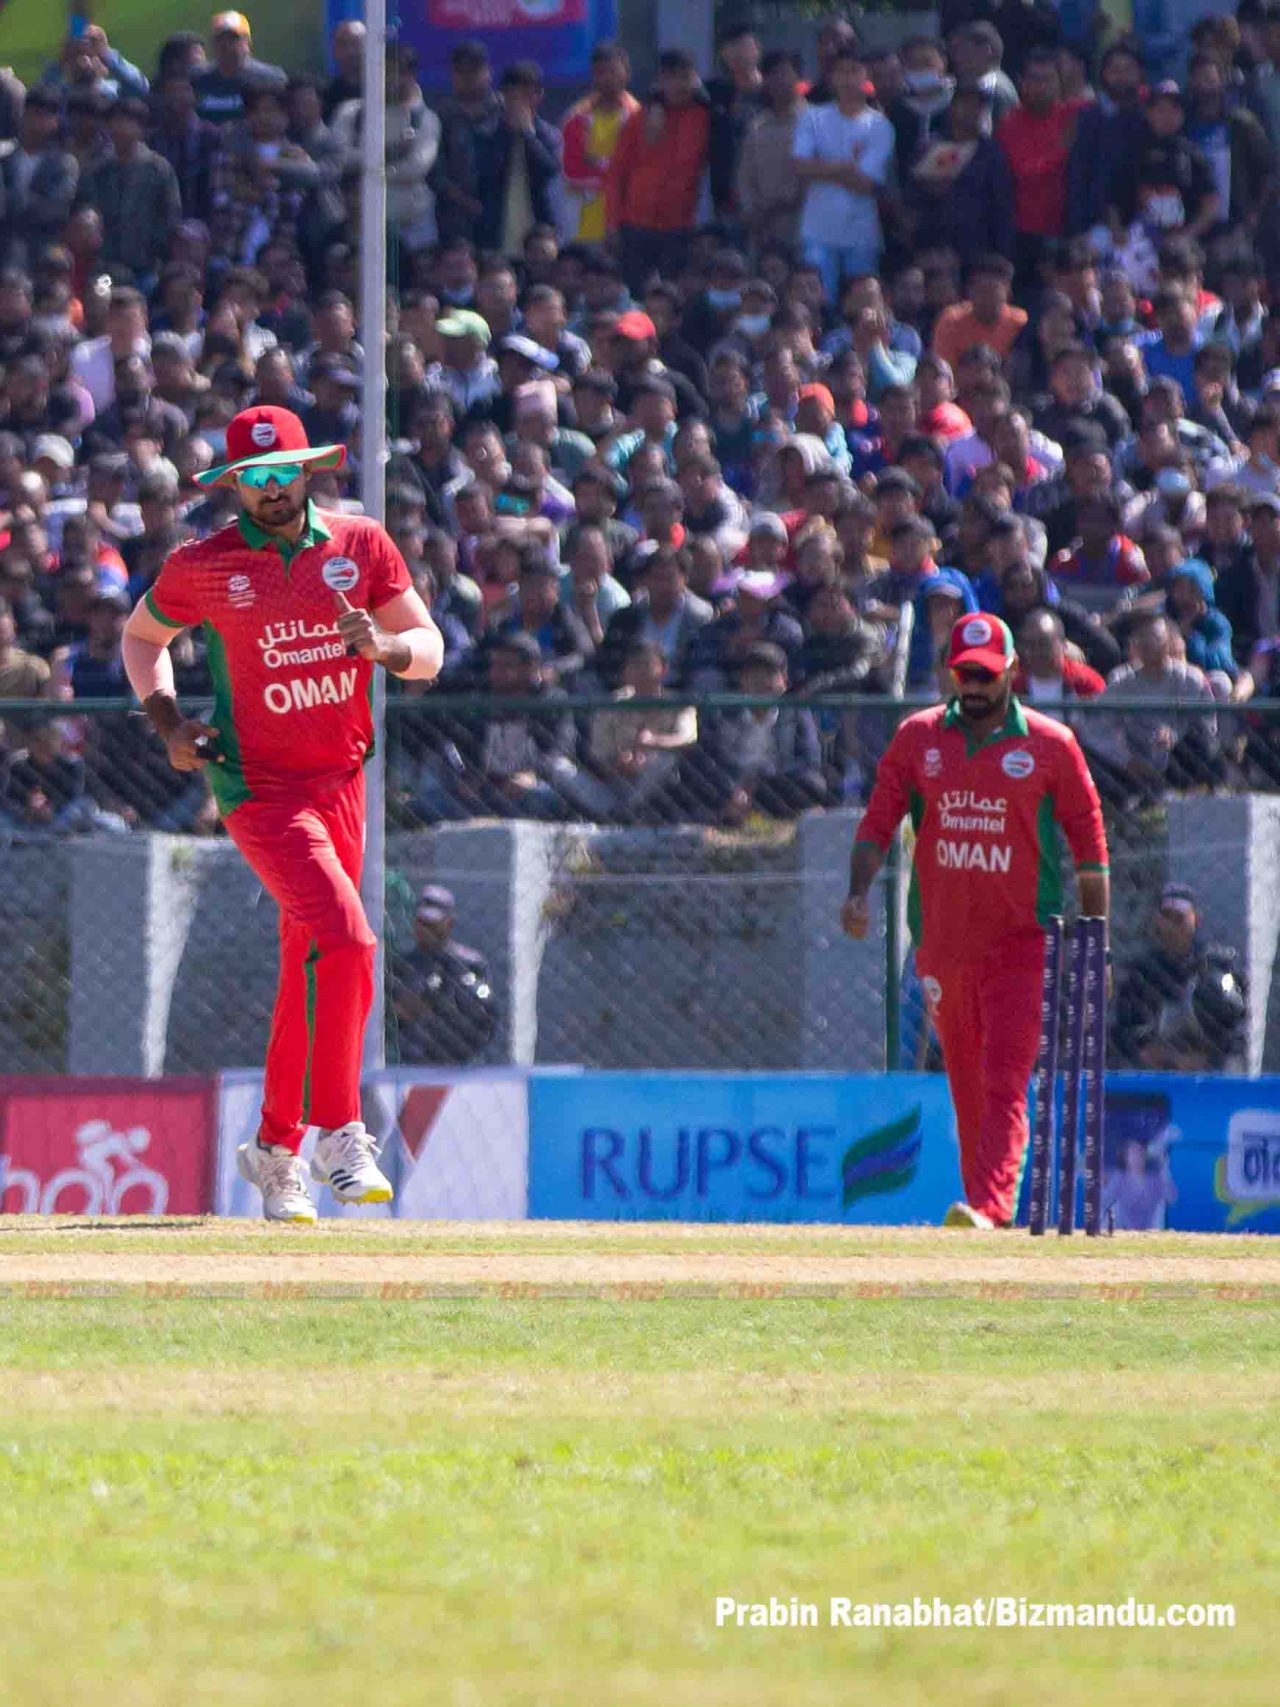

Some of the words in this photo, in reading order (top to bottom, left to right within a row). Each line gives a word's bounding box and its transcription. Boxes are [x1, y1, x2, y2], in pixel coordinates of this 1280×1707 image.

[263, 668, 358, 714] OMAN
[940, 812, 1006, 834] Omantel
[936, 839, 1012, 873] OMAN
[580, 1127, 839, 1199] RUPSE
